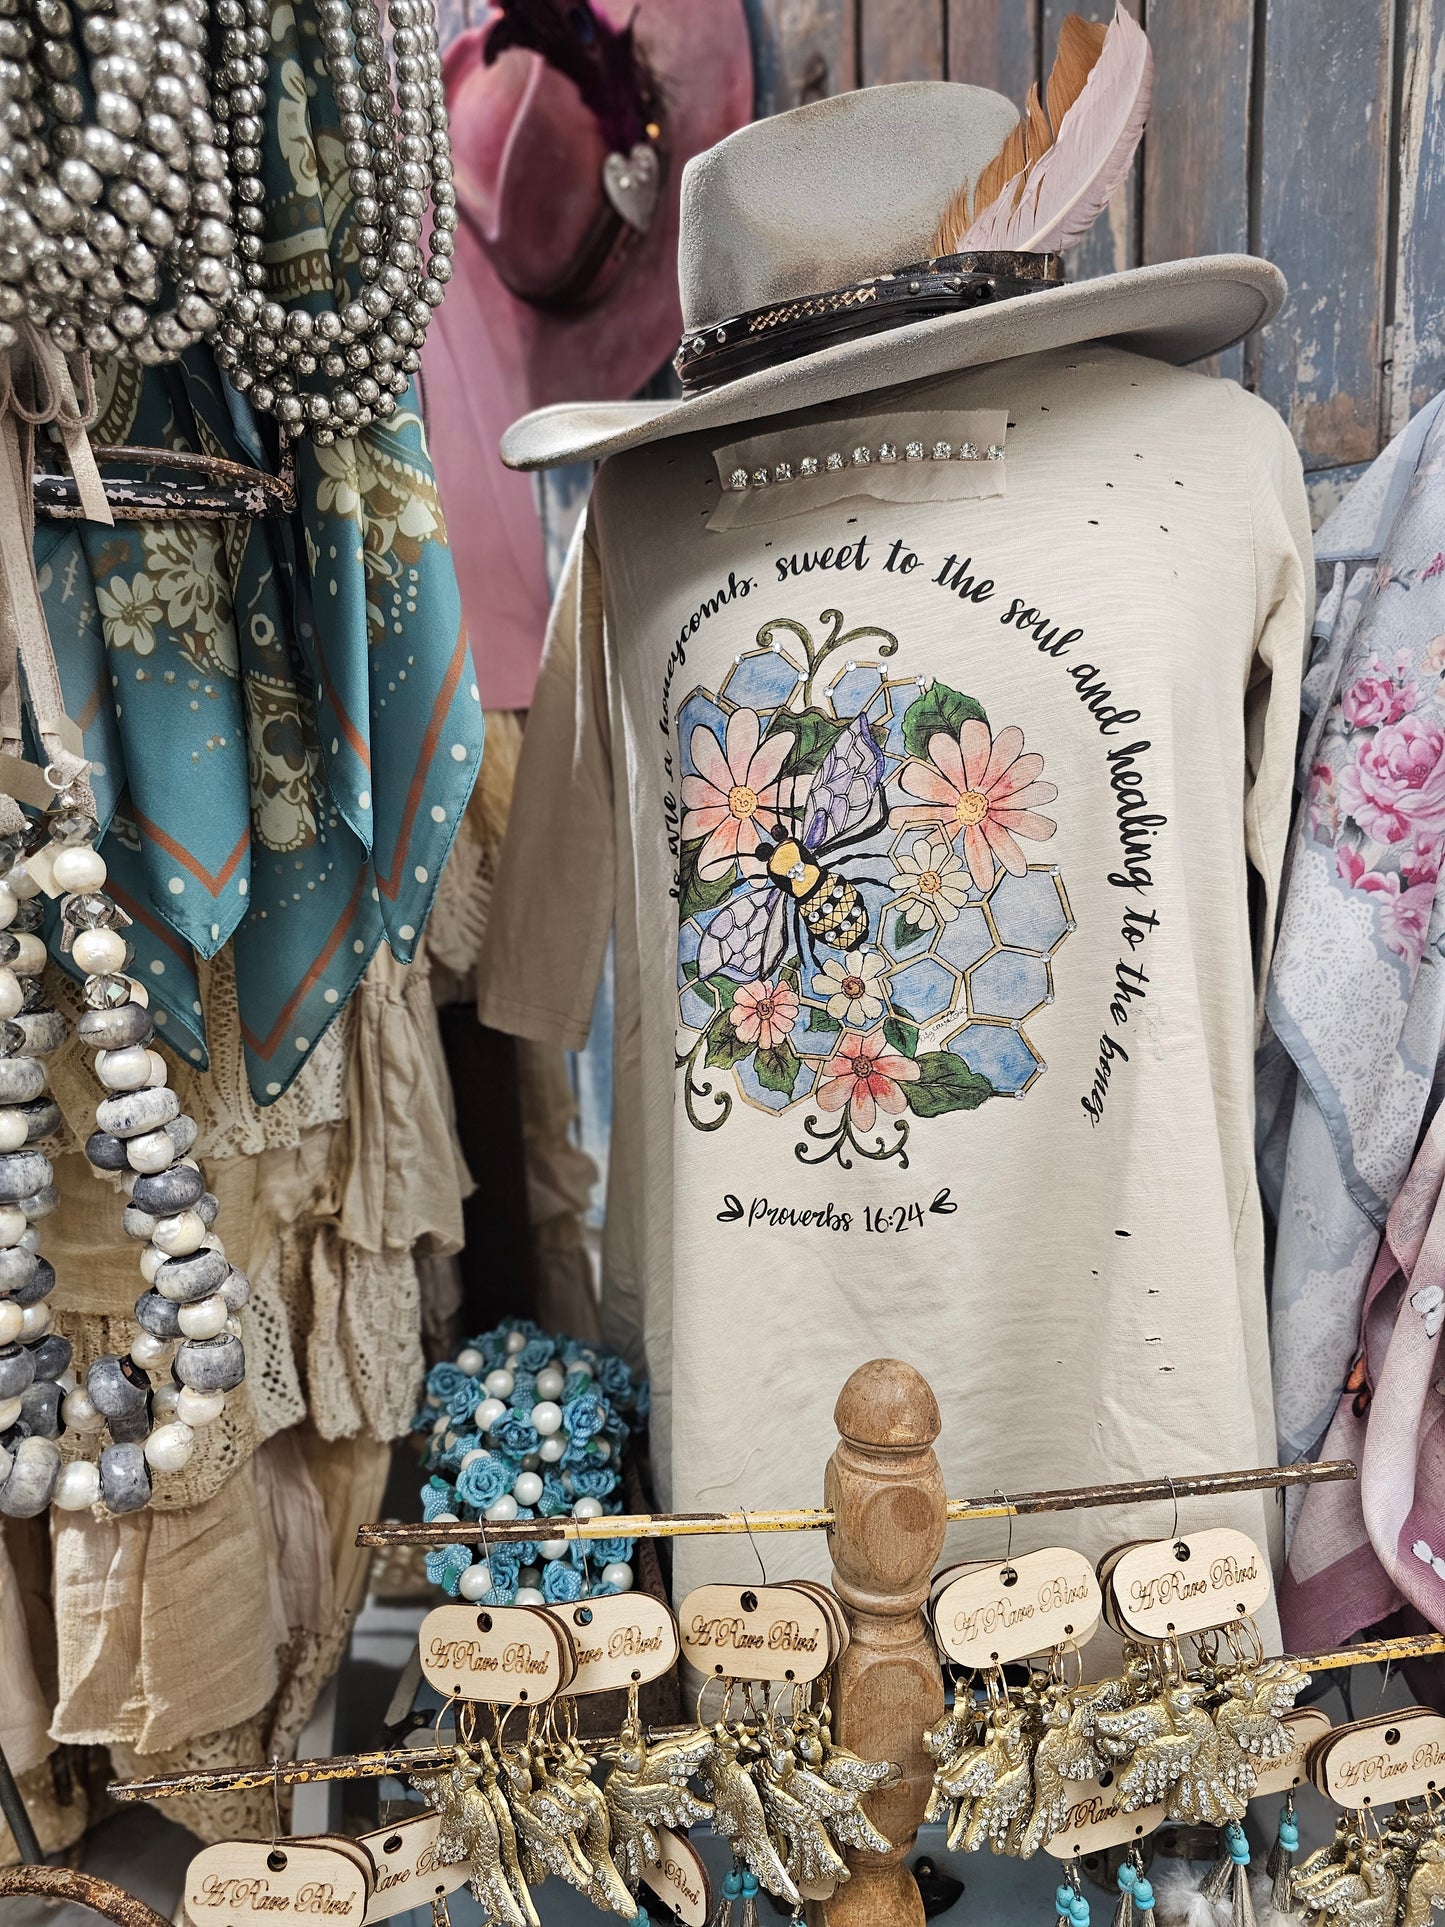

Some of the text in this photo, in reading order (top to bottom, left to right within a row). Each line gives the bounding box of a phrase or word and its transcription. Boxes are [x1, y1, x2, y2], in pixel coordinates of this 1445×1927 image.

[775, 535, 870, 583] sweet
[882, 539, 924, 574] to
[931, 554, 995, 604] the
[1000, 598, 1084, 658] soul
[1066, 663, 1141, 736] and
[664, 750, 674, 782] a
[664, 791, 680, 858] are
[1106, 740, 1168, 896] healing
[1121, 905, 1161, 952] to
[1109, 958, 1150, 1026] the
[748, 1197, 925, 1234] Proverbs 16:24
[1127, 1555, 1258, 1614] A Rare Bird
[685, 1614, 820, 1653] A Rare Bird
[951, 1573, 1090, 1646] A Rare Bird
[425, 1637, 550, 1675] A Rare Bird
[573, 1625, 663, 1666] are Bird
[1334, 1761, 1367, 1790] A
[1362, 1753, 1409, 1782] Rare
[192, 1873, 357, 1915] A Rare Bird
[664, 1858, 700, 1906] Bird
